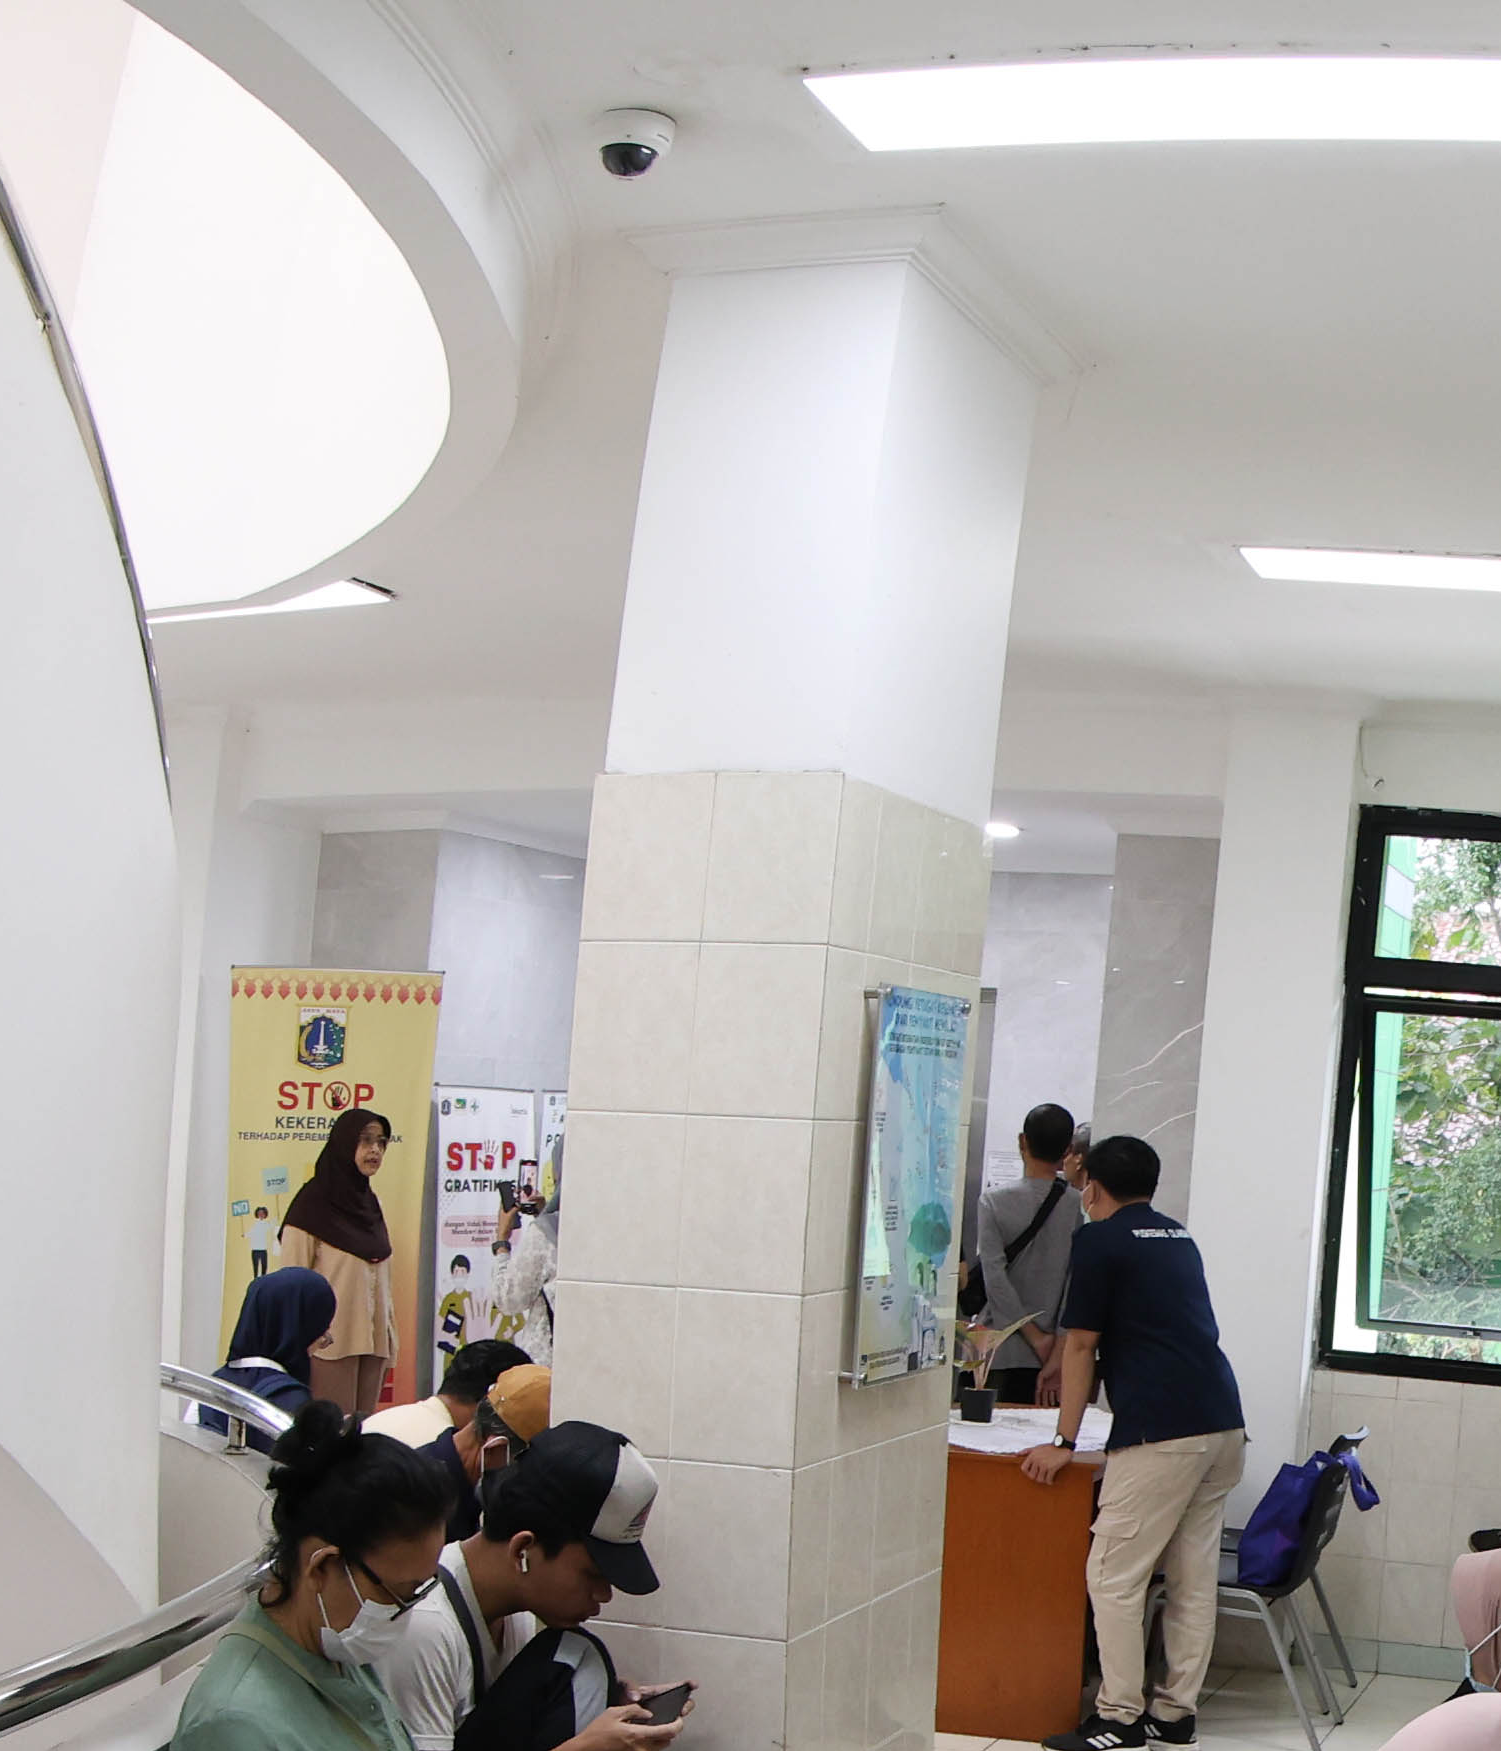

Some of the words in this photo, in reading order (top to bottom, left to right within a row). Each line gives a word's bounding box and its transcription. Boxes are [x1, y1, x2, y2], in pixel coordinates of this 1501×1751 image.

[275, 1116, 336, 1129] KEKERA
[238, 1131, 290, 1141] TERHADAP
[233, 1202, 249, 1215] NO
